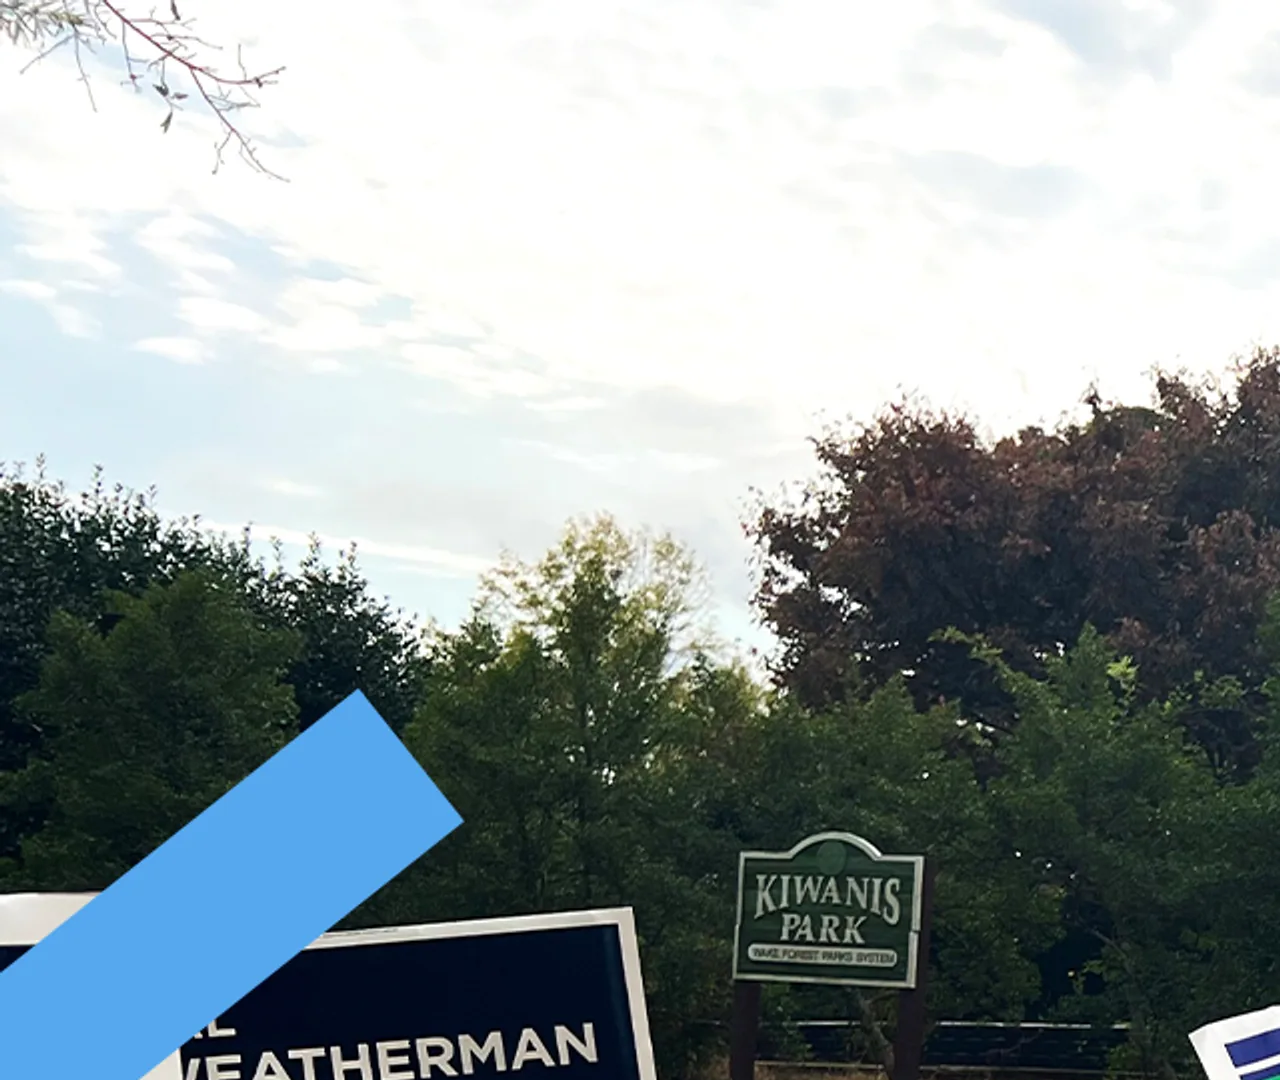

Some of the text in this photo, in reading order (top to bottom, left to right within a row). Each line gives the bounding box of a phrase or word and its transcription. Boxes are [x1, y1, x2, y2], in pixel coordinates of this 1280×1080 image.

[754, 874, 900, 925] KIWANIS
[780, 914, 867, 944] PARK
[856, 952, 896, 965] SYSTEM
